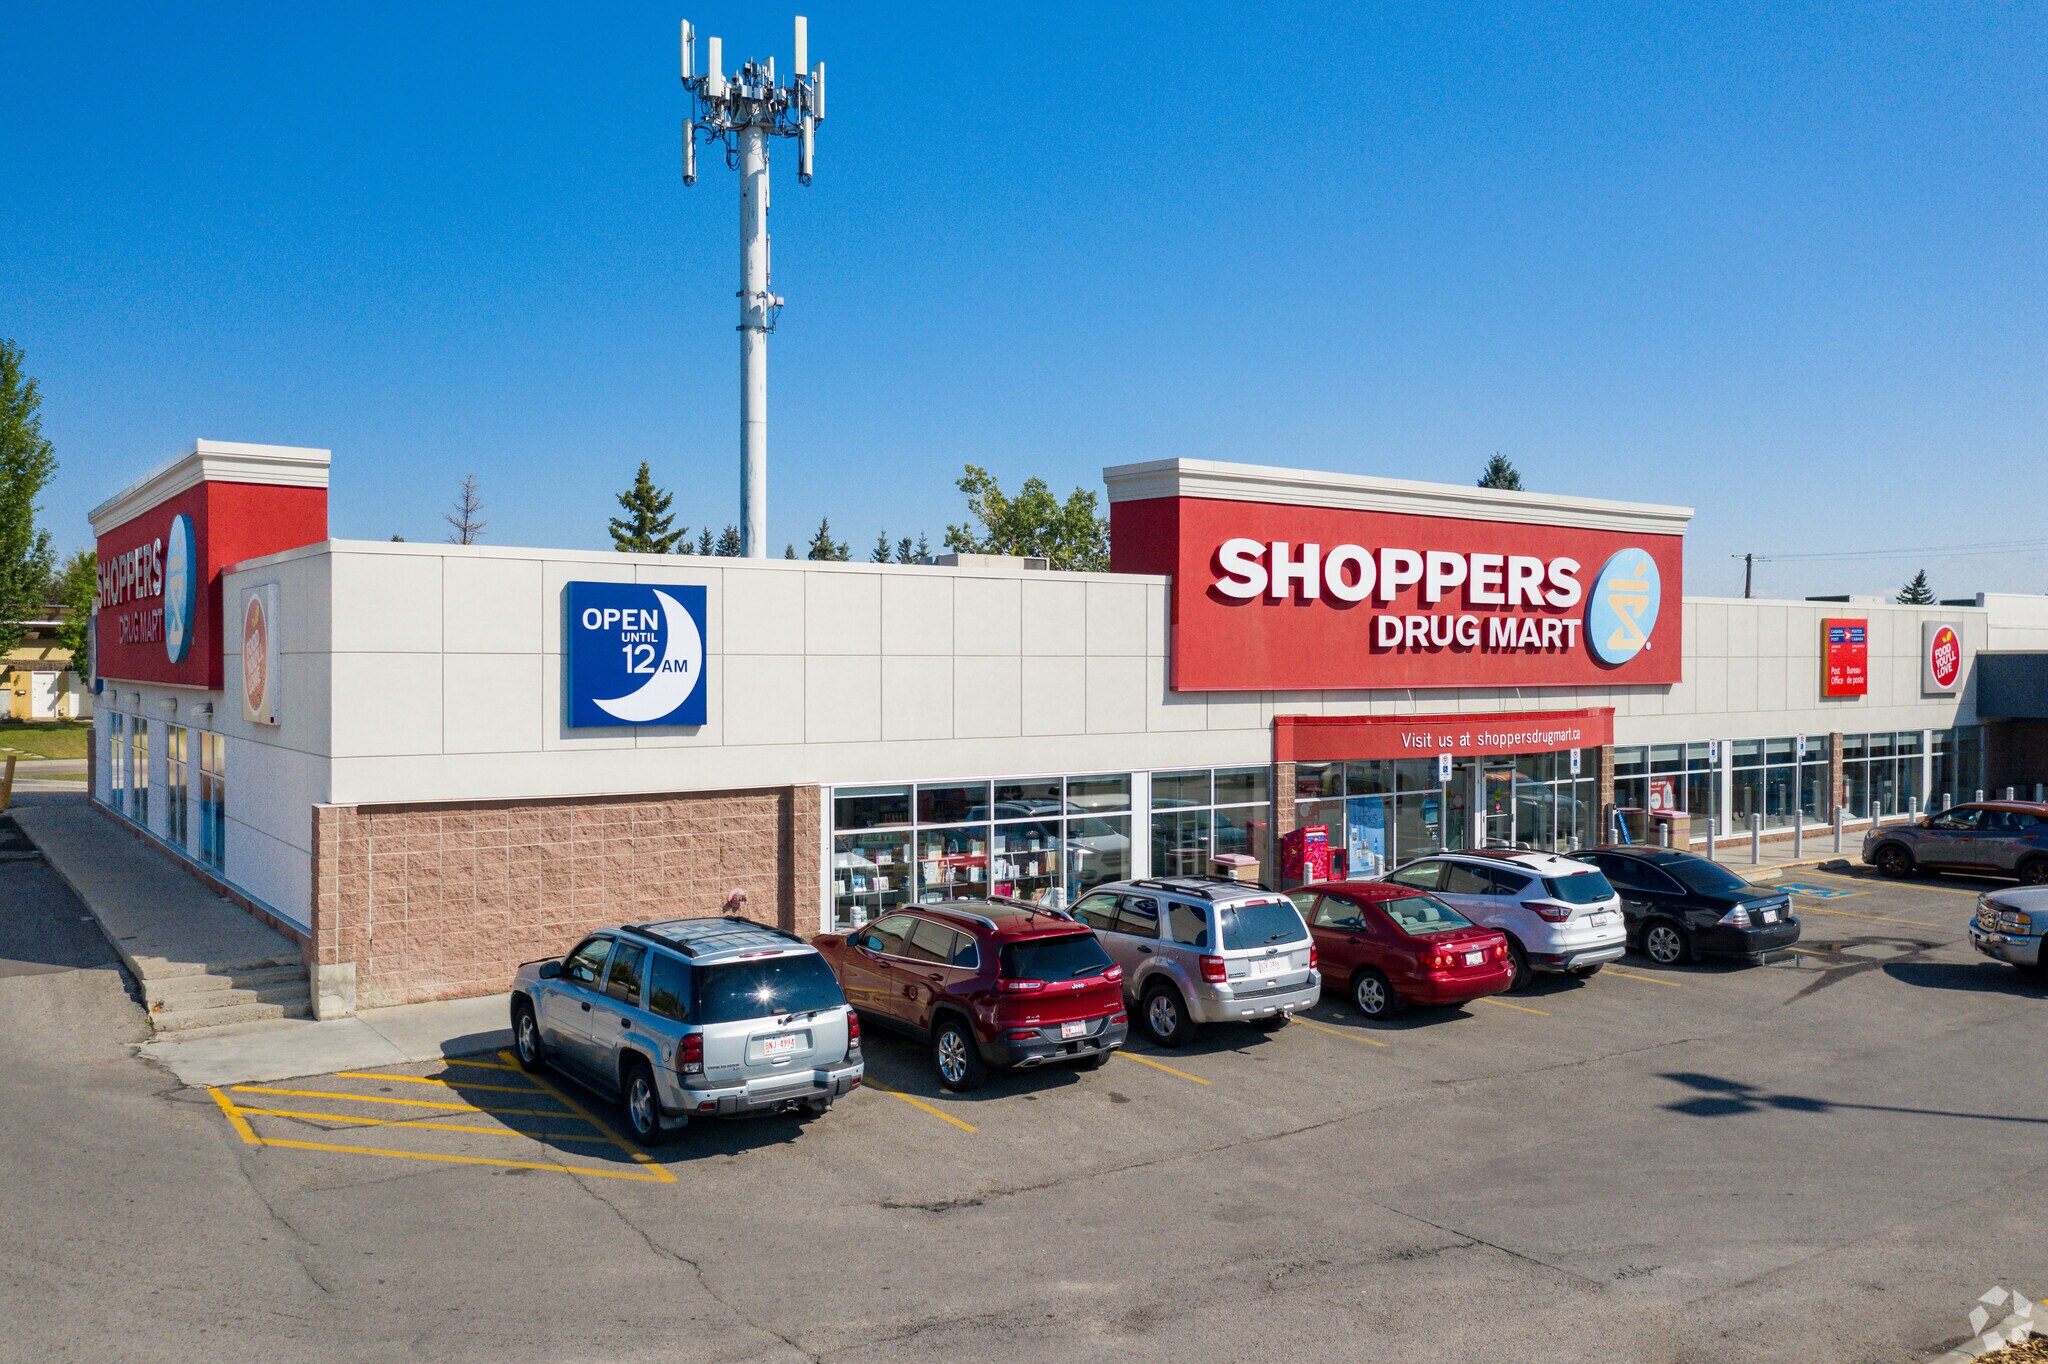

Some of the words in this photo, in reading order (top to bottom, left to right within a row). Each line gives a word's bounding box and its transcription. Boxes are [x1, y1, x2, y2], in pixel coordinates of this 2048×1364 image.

[96, 538, 163, 609] SHOPPERS
[1214, 537, 1582, 608] SHOPPERS
[119, 611, 139, 644] DRUG
[140, 608, 163, 642] MART
[582, 608, 659, 631] OPEN
[621, 632, 658, 643] UNTIL
[1377, 614, 1480, 648] DRUG
[1489, 617, 1582, 649] MART
[622, 643, 656, 674] 12
[661, 659, 688, 673] AM
[1935, 643, 1952, 660] FOOD
[1936, 651, 1957, 669] YOU'LL
[1831, 666, 1841, 675] Post
[1846, 666, 1861, 674] Bureau
[1937, 662, 1953, 679] LOVE
[1831, 676, 1844, 685] Office
[1846, 676, 1852, 684] de
[1853, 677, 1864, 685] poste
[1401, 732, 1432, 748] Visit
[1438, 735, 1453, 747] us
[1459, 732, 1471, 747] at
[1477, 727, 1581, 748] shoppersdrugmart.ca
